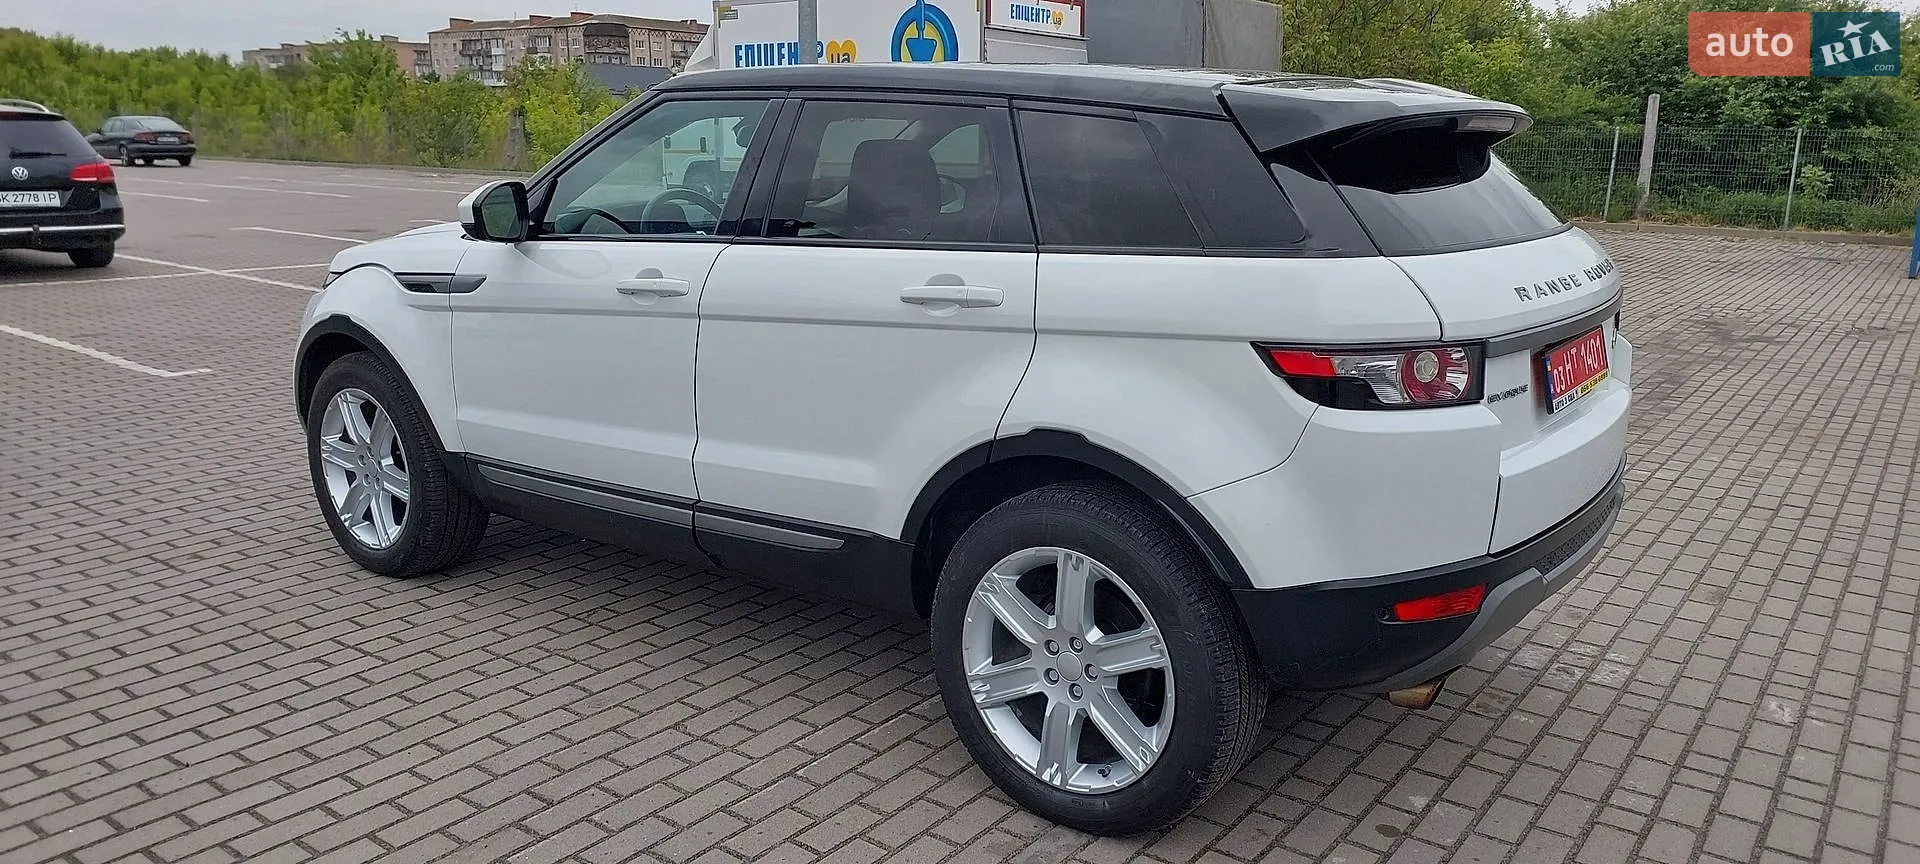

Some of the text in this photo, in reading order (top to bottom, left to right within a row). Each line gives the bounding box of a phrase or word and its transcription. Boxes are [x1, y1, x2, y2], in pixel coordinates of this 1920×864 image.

[12, 193, 40, 203] 2778
[1513, 273, 1582, 302] RANGE
[1580, 335, 1604, 375] 1401
